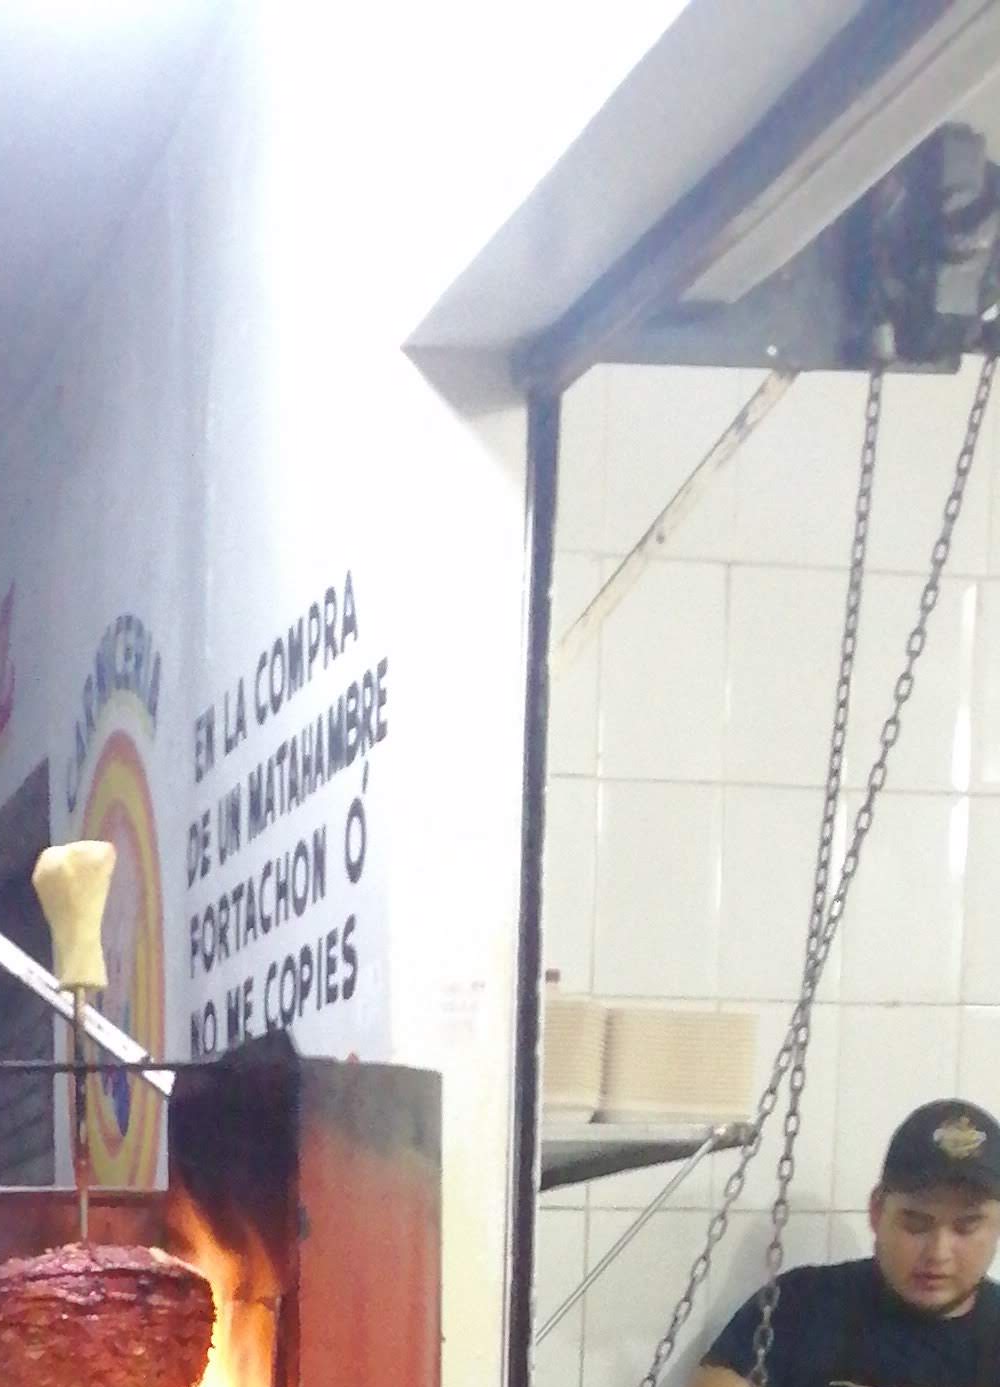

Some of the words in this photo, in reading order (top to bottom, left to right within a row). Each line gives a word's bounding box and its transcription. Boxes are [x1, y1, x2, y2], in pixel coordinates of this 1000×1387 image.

[195, 704, 216, 783] EN
[223, 676, 248, 757] LA
[253, 569, 360, 726] COMPRA
[186, 809, 212, 889] DE
[217, 782, 242, 865] UN
[247, 656, 389, 845] MATAHAMBRE
[189, 823, 327, 980] FORTACHON
[190, 1000, 218, 1061] NO
[226, 976, 254, 1051] ME
[264, 914, 359, 1032] COPIES
